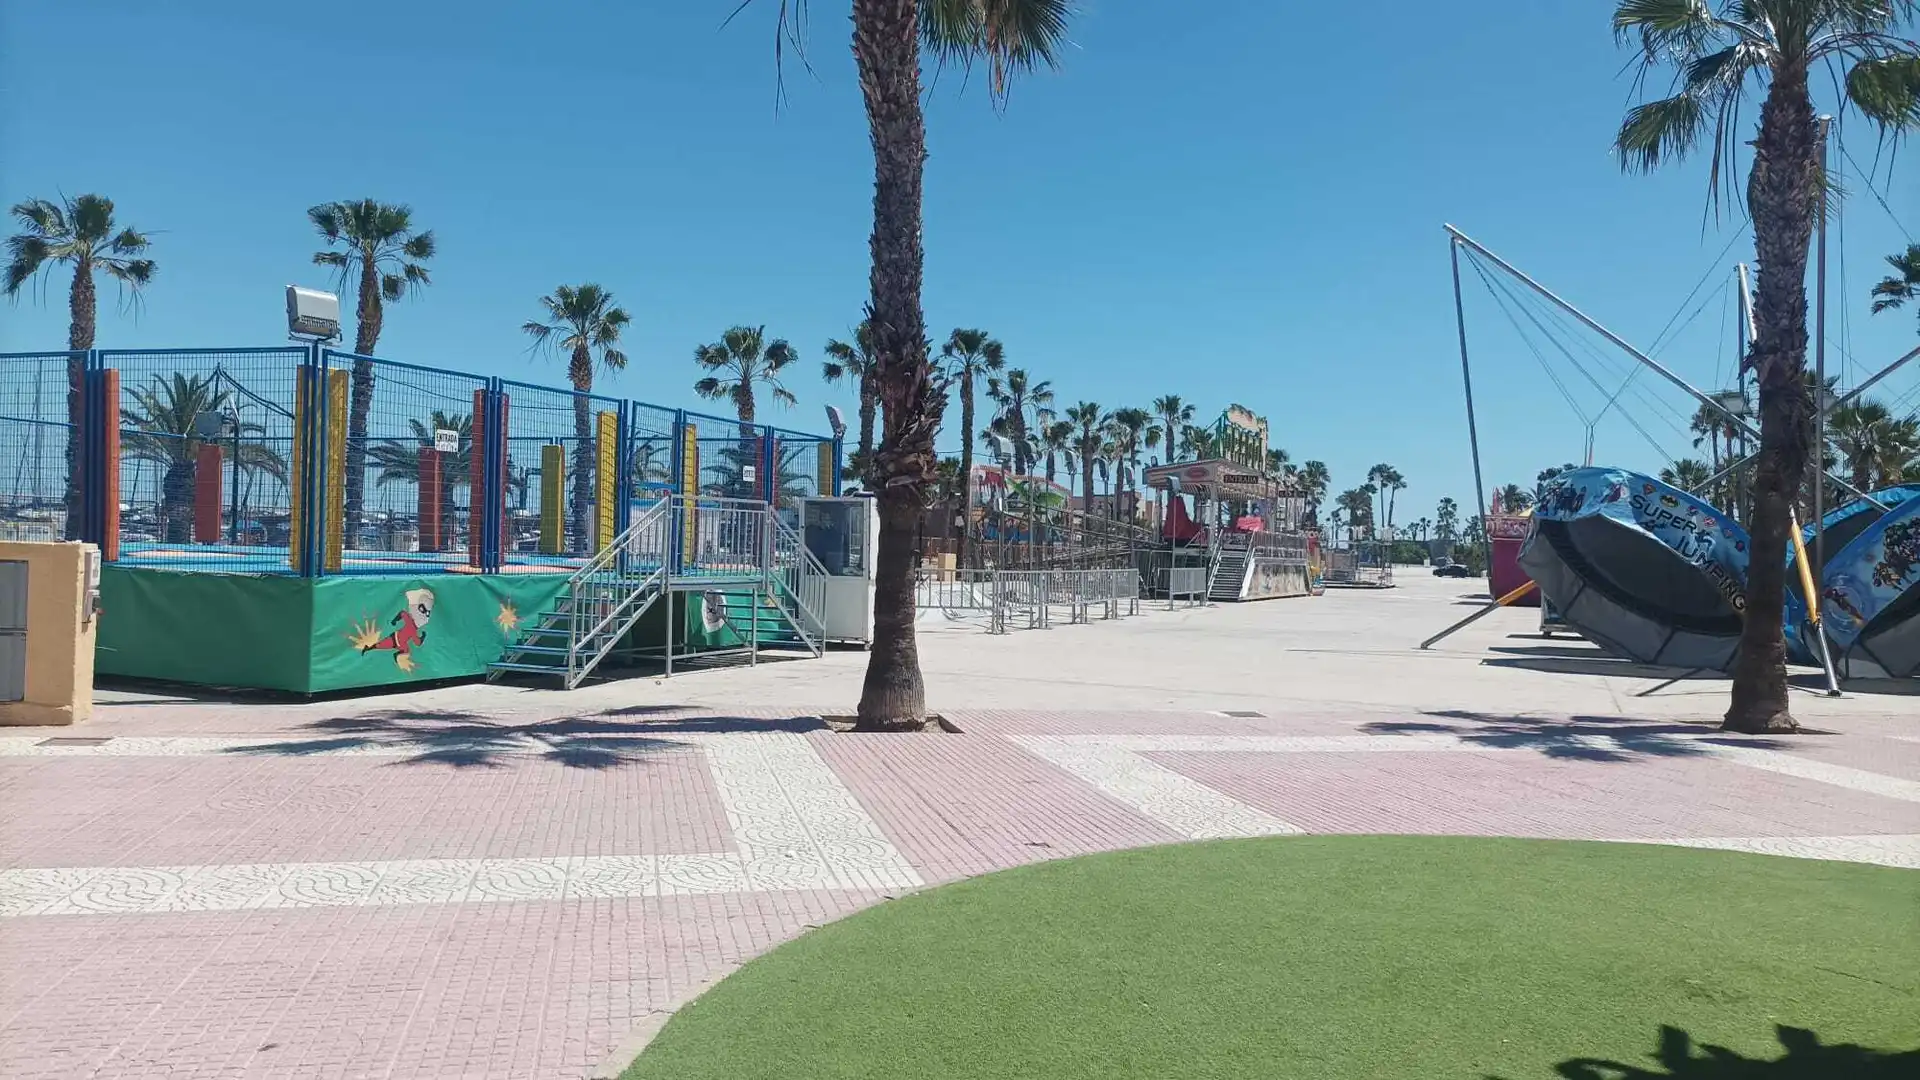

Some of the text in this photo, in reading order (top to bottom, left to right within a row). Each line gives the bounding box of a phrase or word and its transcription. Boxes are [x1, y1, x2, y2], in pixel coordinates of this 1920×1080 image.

[437, 433, 457, 442] ENTRADA
[1224, 475, 1258, 483] ENTRADA
[1629, 494, 1697, 535] SUPER
[1675, 535, 1747, 613] JUMPING
